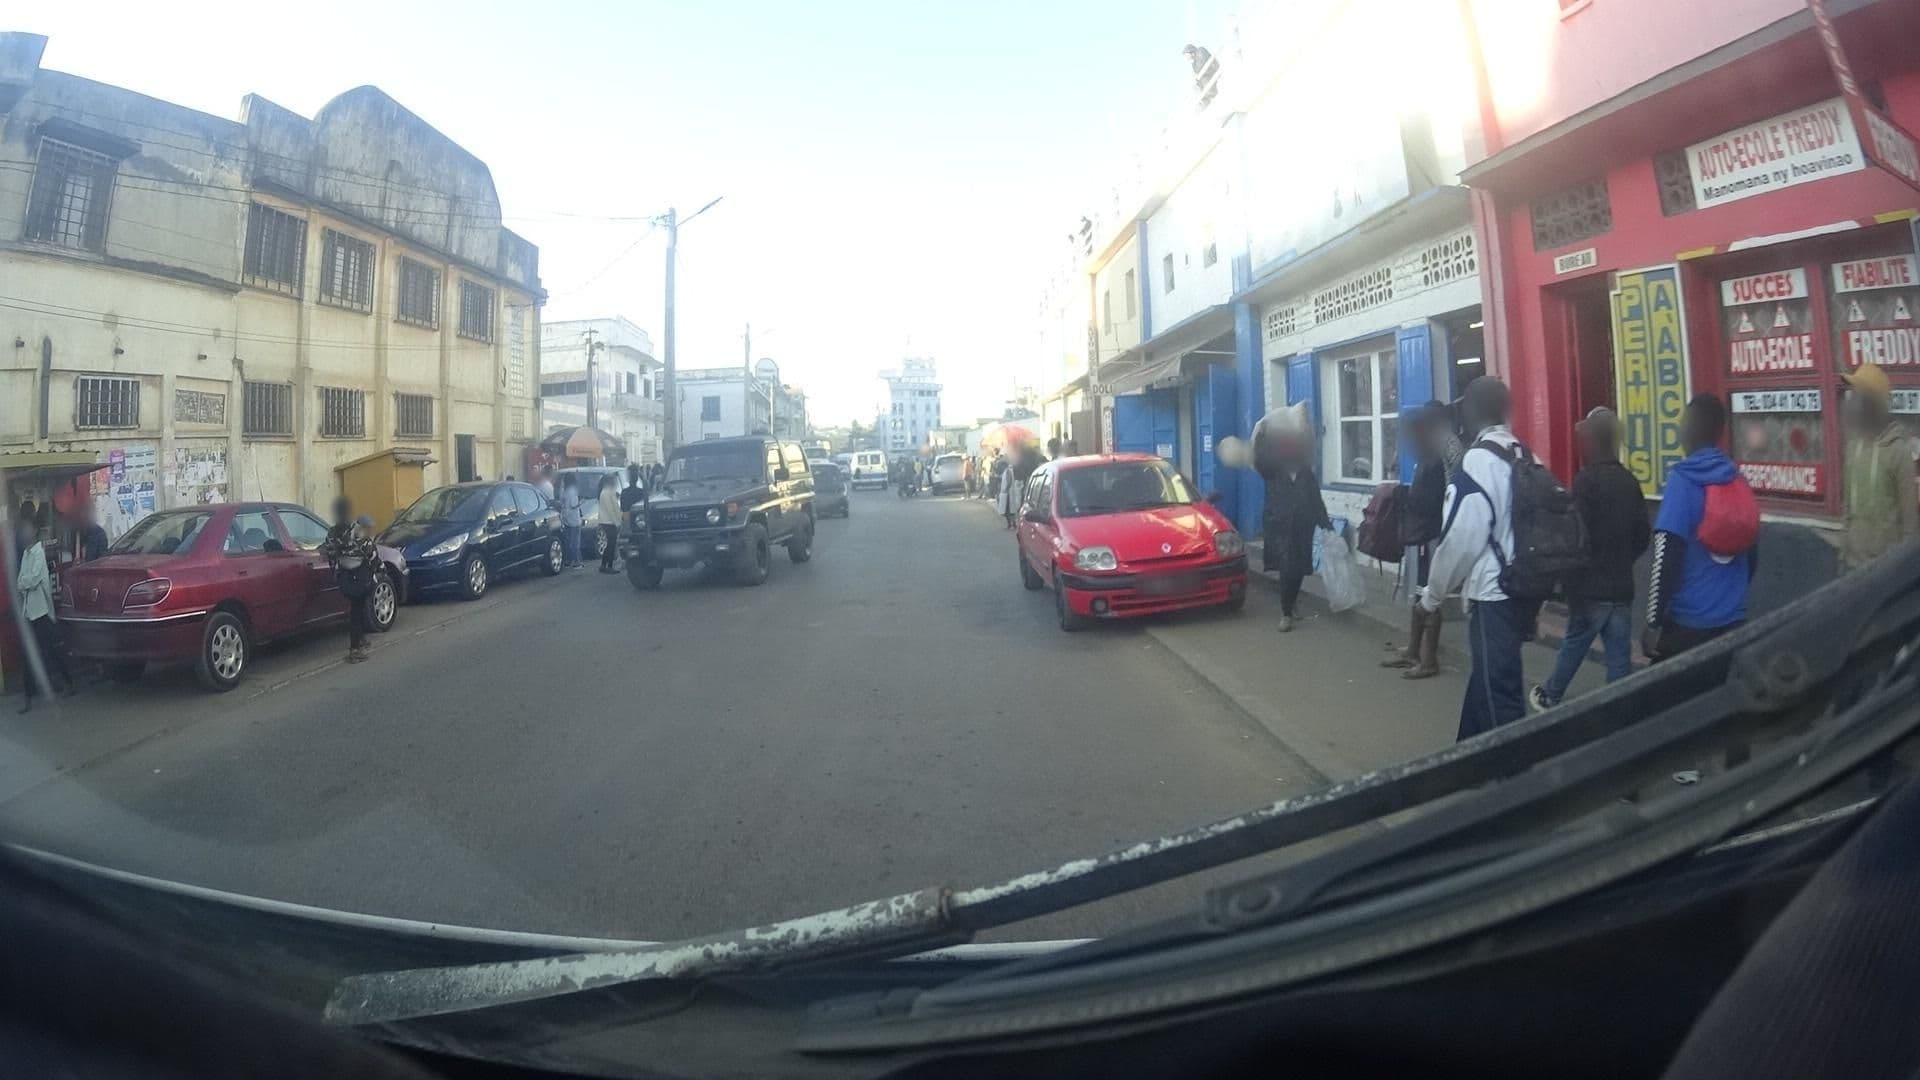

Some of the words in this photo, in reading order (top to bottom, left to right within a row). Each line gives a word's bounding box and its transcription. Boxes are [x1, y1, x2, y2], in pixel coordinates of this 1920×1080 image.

[1699, 124, 1785, 181] AUTO-ECOLE
[1783, 107, 1844, 156] FREDDY
[1703, 175, 1770, 201] Manomana
[1772, 168, 1790, 184] ny
[1791, 153, 1854, 176] hoavinao
[1559, 252, 1592, 271] BUREAU
[1842, 258, 1911, 289] FIABILITE
[1732, 273, 1794, 303] SUCCES
[1730, 335, 1814, 373] AUTO-ECOLE
[1849, 328, 1920, 366] FREDDY
[1738, 463, 1817, 493] PERFORMANCE
